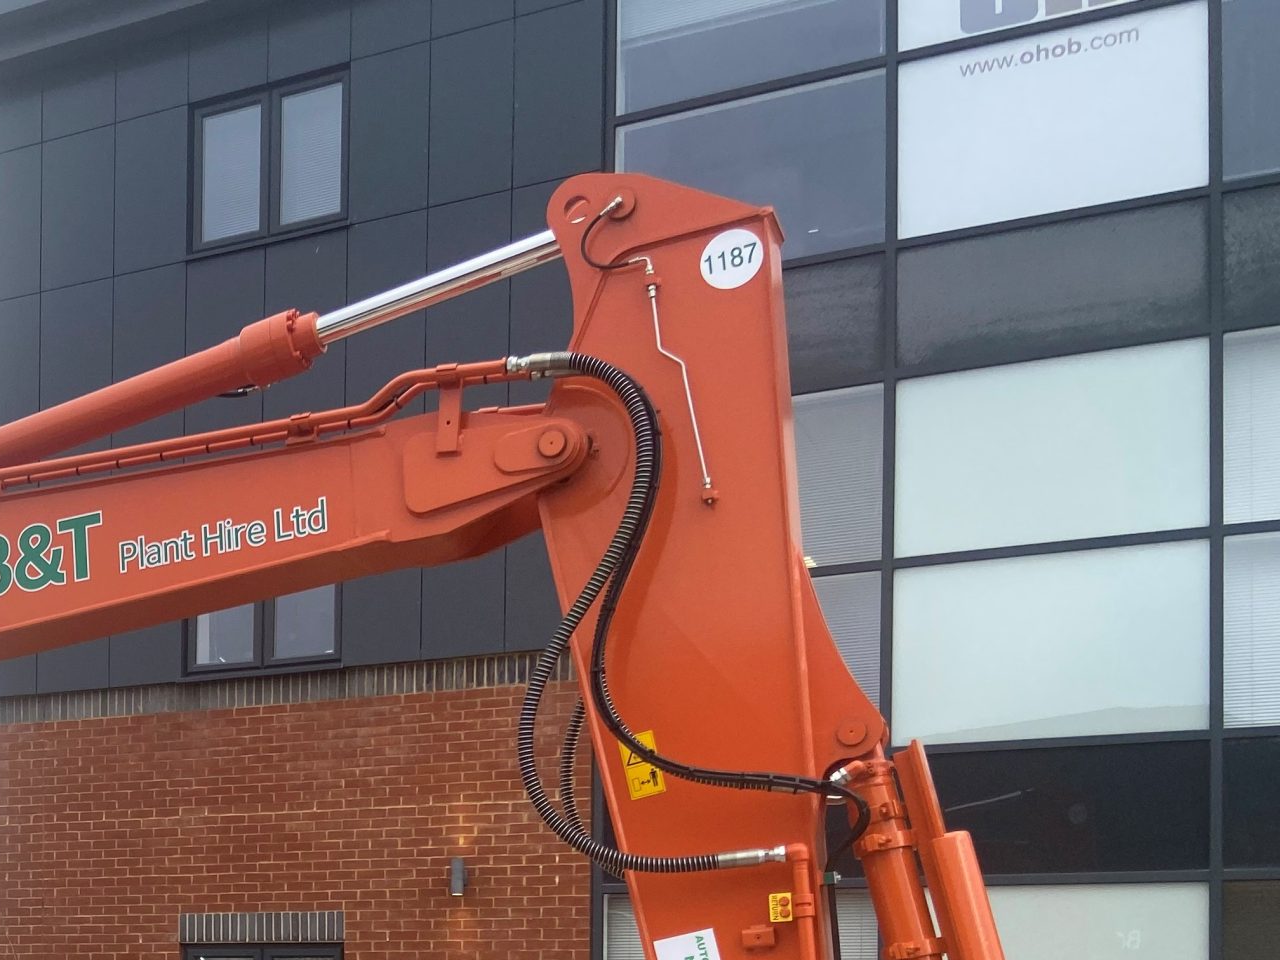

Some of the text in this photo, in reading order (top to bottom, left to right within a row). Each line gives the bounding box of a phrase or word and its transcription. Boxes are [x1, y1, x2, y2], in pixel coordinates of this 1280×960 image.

[959, 26, 1140, 77] www.ohob.com
[704, 241, 757, 275] 1187
[119, 529, 196, 574] Plant
[201, 517, 267, 557] Hire
[273, 496, 328, 542] Ltd
[771, 895, 780, 921] RETURN
